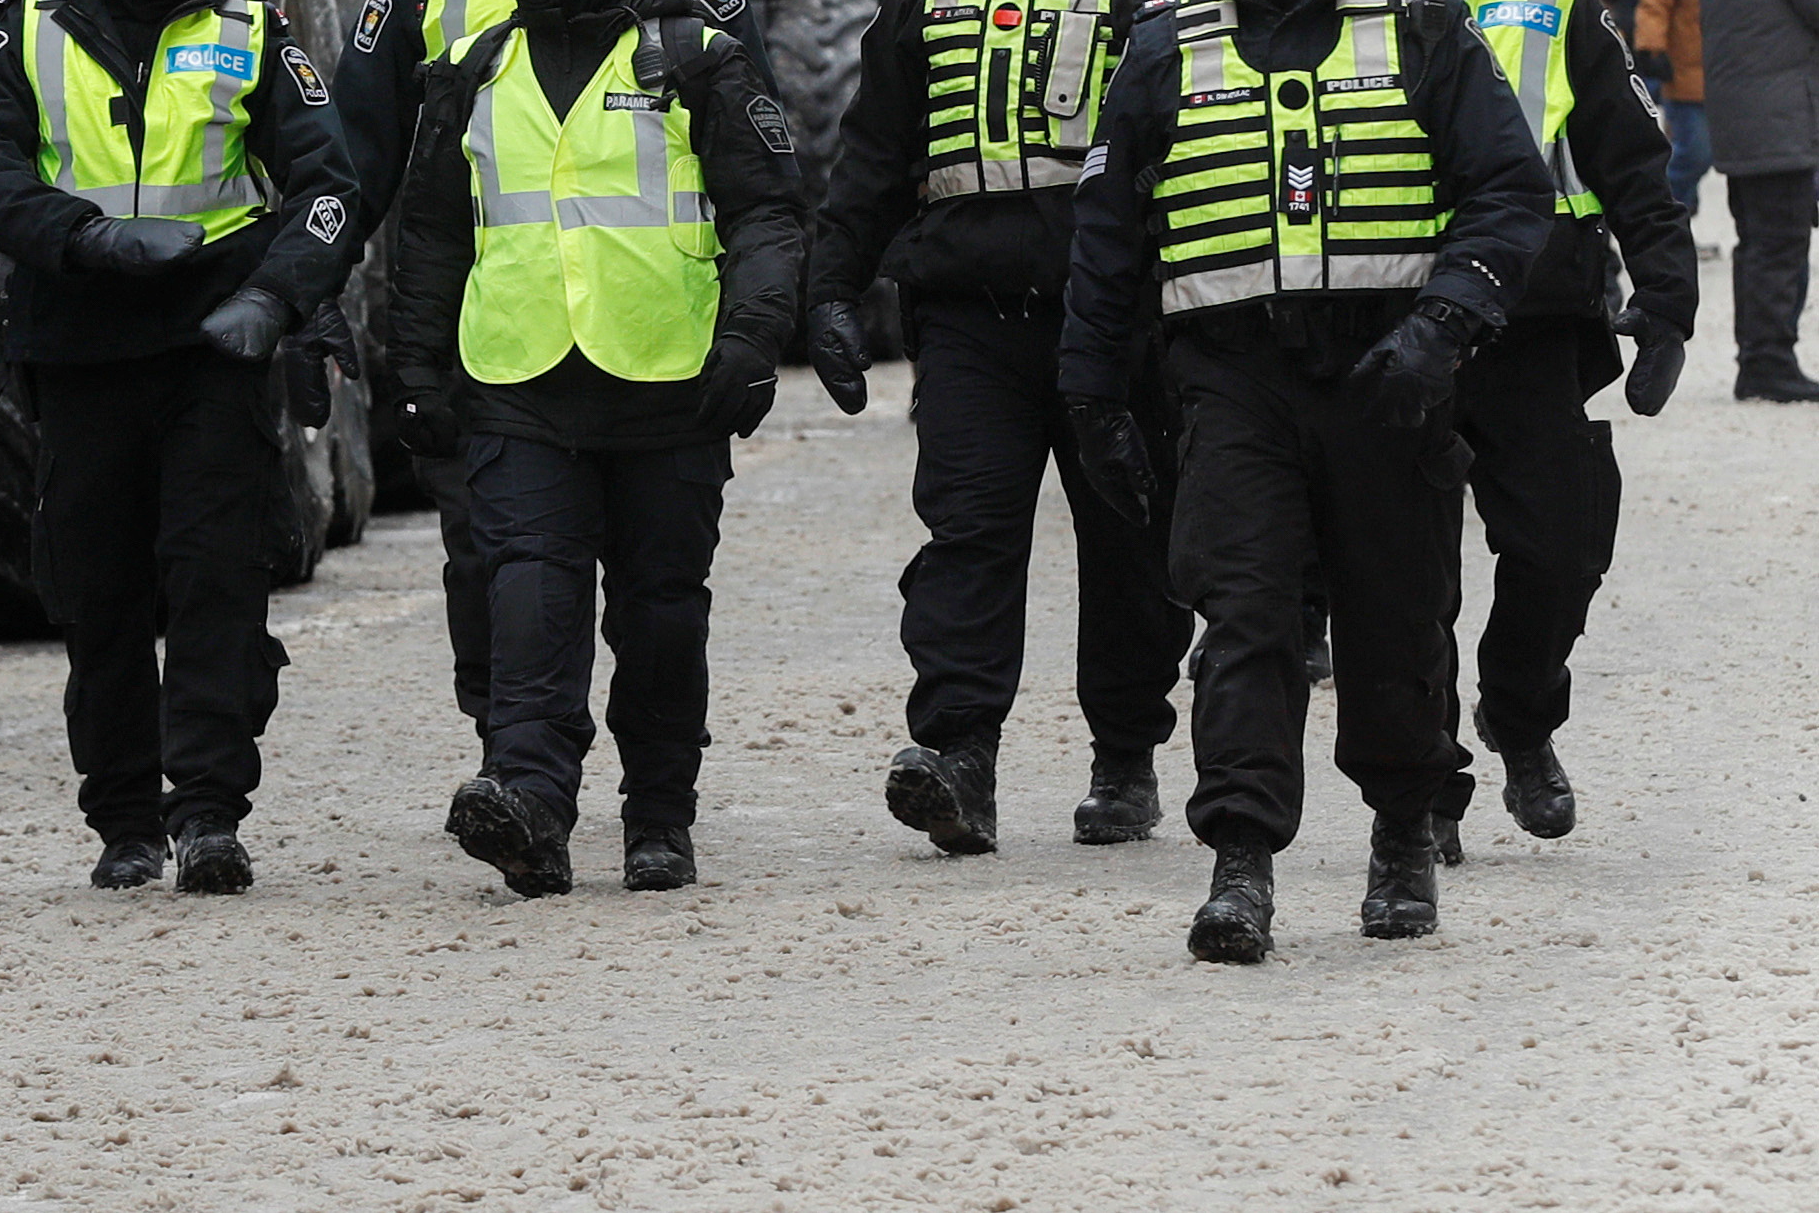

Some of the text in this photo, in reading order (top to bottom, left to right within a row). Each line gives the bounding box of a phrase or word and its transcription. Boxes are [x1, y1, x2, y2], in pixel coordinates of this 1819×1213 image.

[1485, 3, 1555, 28] POLICE
[174, 49, 245, 72] POLICE
[1327, 76, 1394, 91] POLICE
[1289, 202, 1310, 212] 1741
